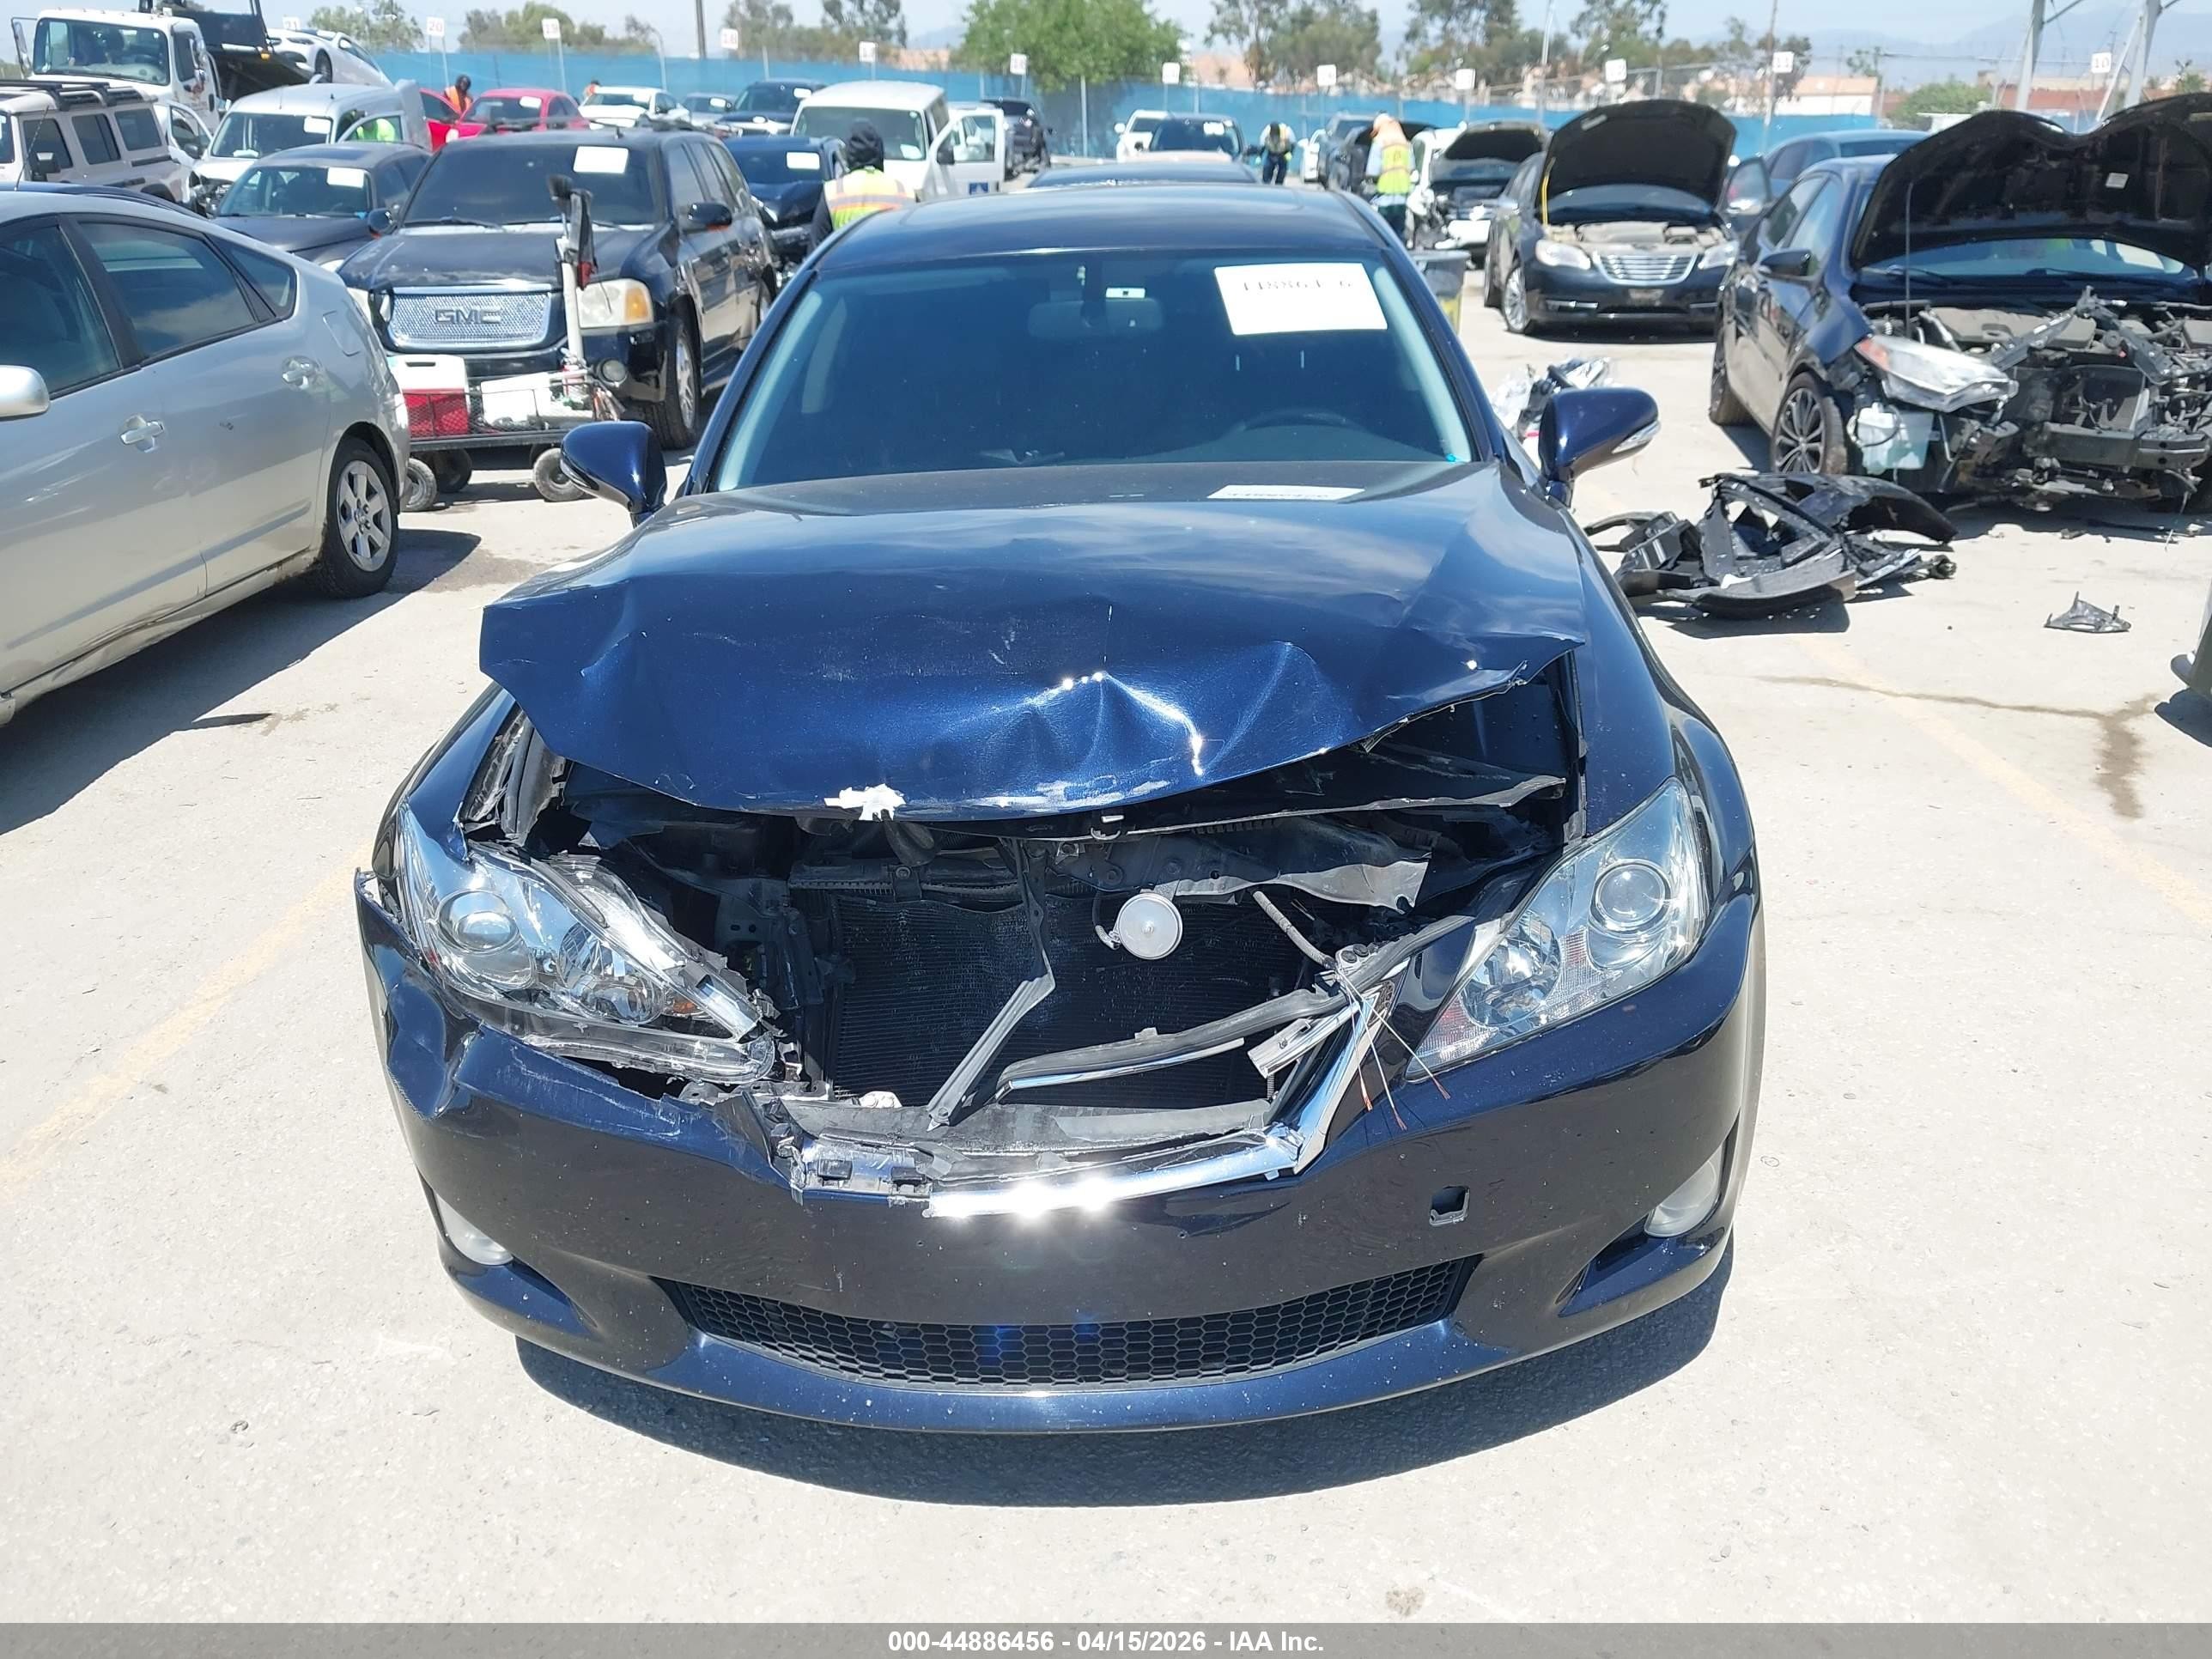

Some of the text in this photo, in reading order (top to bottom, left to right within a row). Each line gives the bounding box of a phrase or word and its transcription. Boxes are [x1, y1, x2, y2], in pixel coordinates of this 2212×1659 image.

[428, 19, 443, 32] 20
[2094, 56, 2109, 69] 10
[434, 309, 501, 324] GMC
